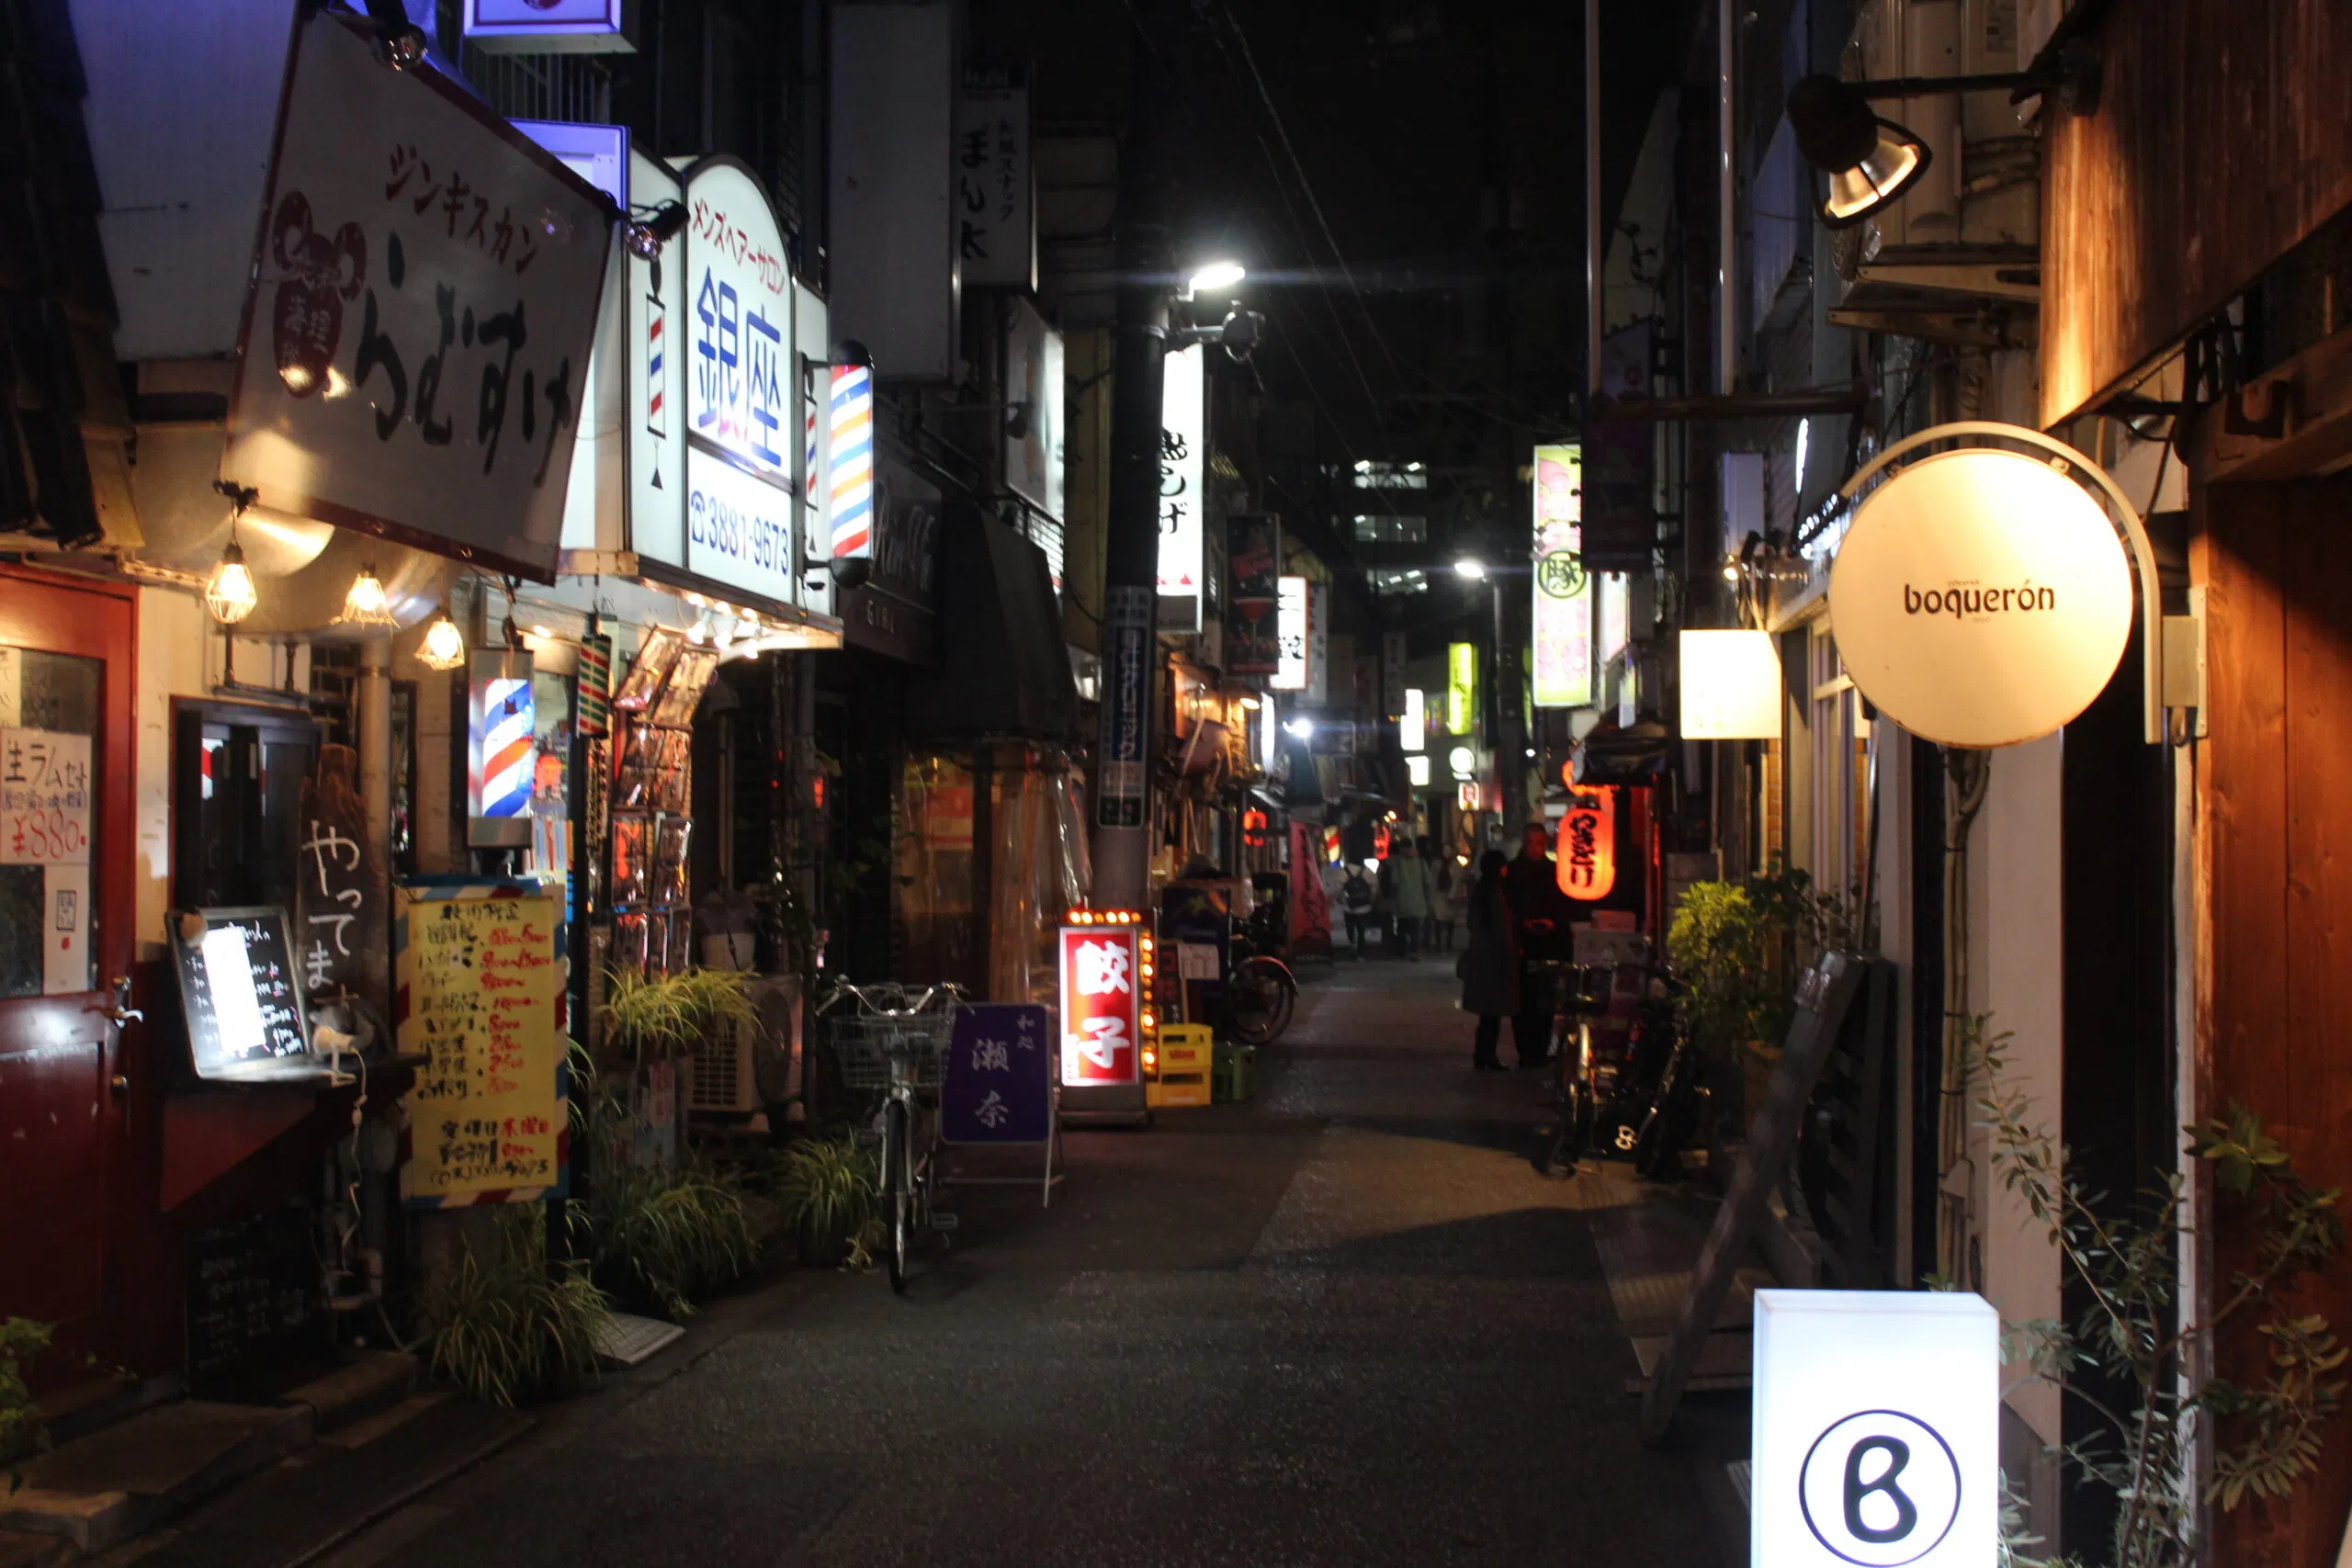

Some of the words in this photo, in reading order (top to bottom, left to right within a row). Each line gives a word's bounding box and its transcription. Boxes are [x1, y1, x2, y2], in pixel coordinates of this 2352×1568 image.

[692, 197, 786, 295] メンズヘアーサロン
[697, 265, 781, 468] 銀座
[708, 494, 790, 576] 3881-9673
[1904, 580, 2054, 620] boquerón
[1076, 941, 1130, 1070] 餃子
[1843, 1435, 1917, 1543] B
